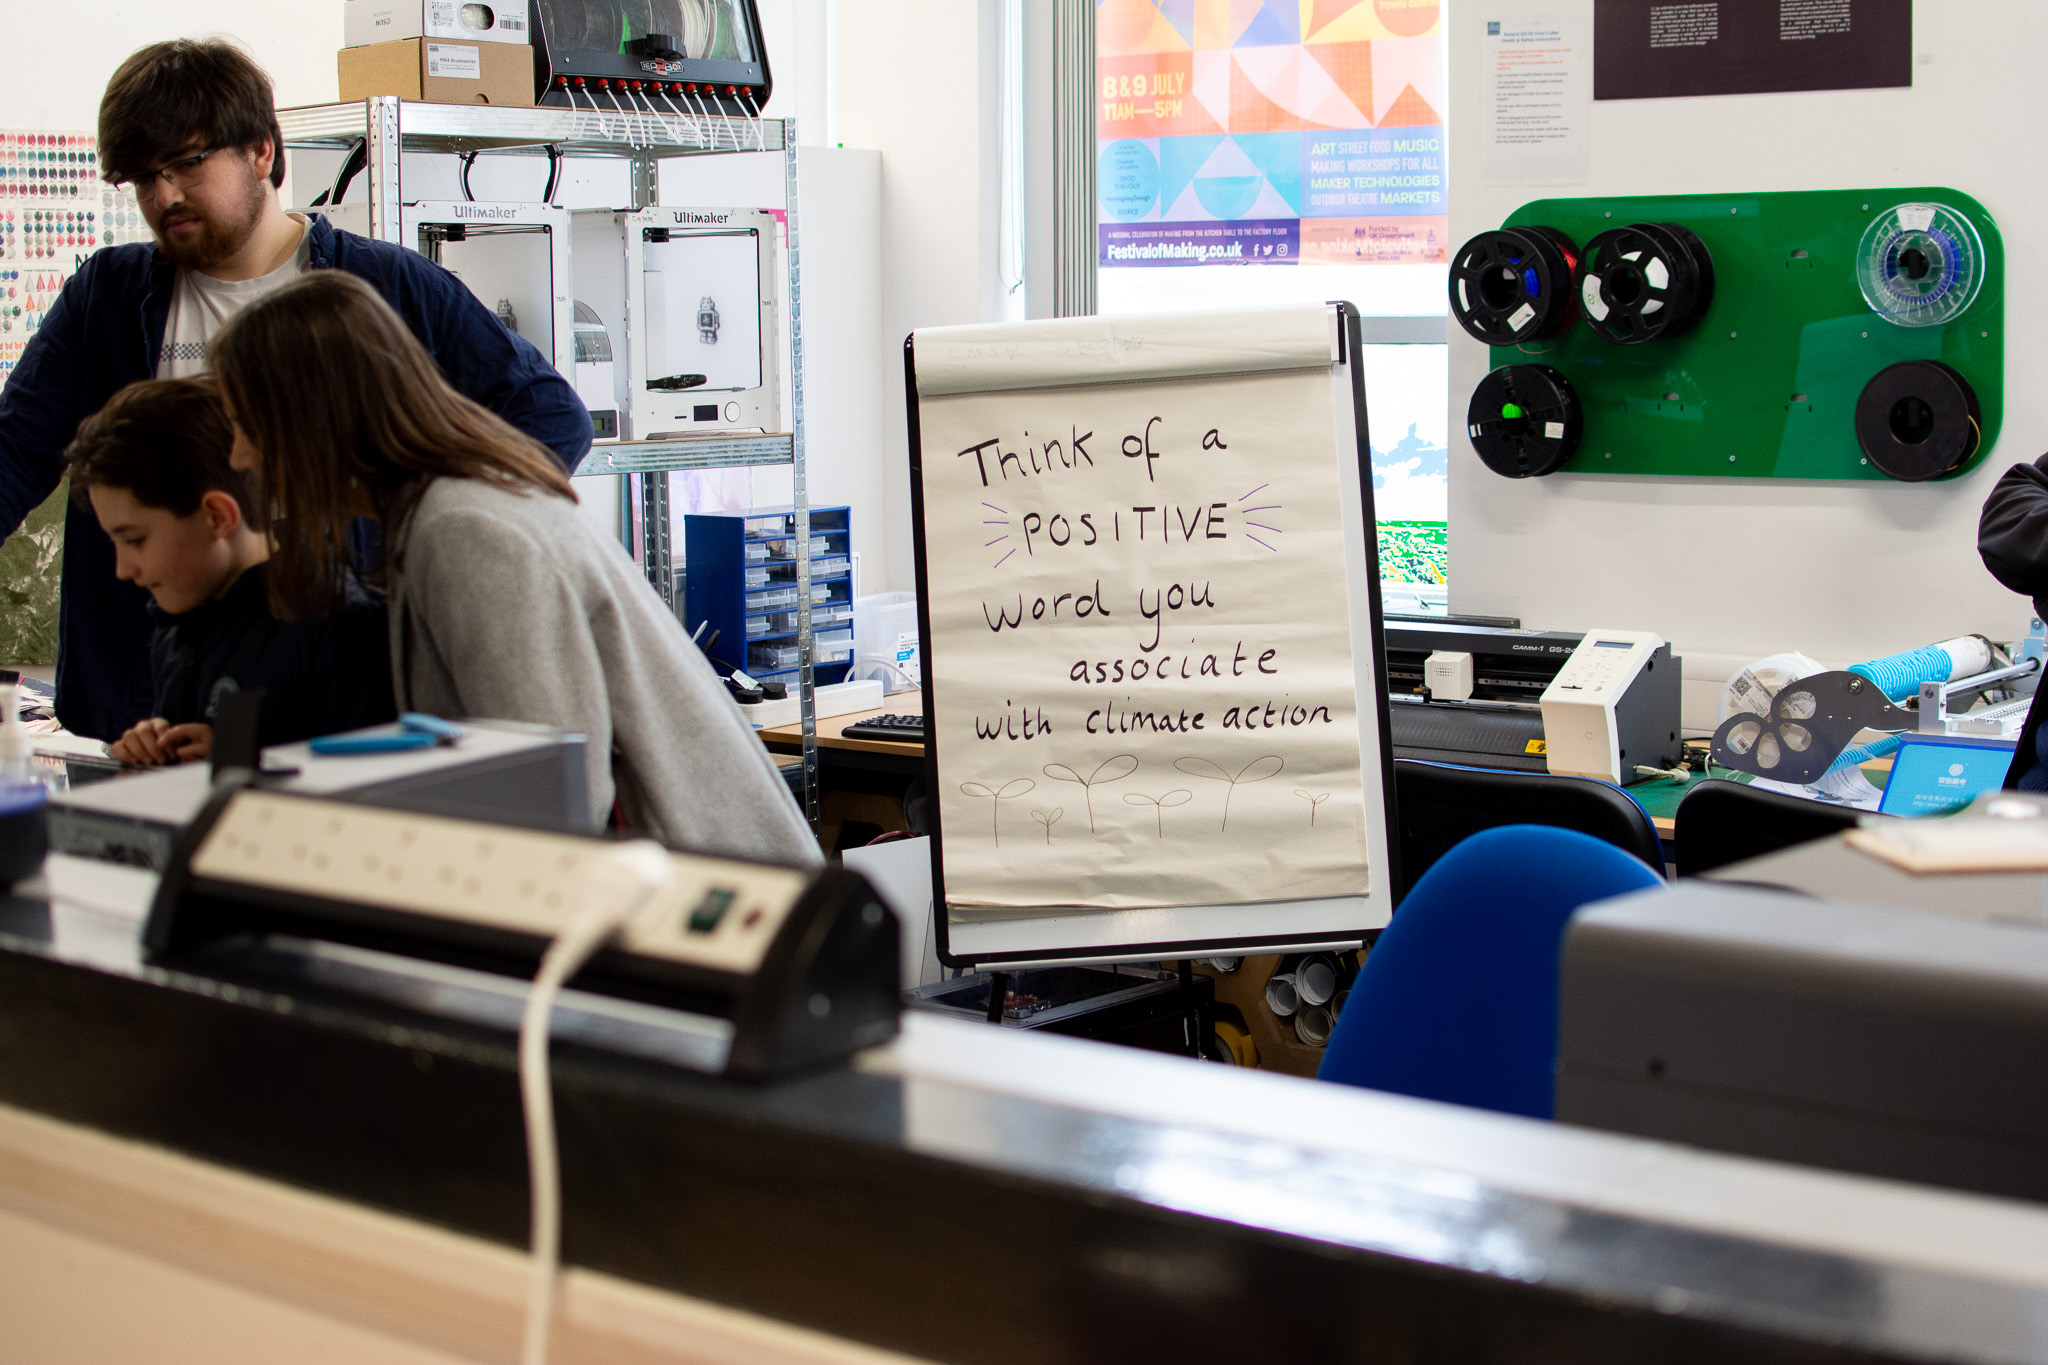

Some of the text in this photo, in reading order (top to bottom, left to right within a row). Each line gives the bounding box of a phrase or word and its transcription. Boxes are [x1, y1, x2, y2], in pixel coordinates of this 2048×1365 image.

[1150, 72, 1184, 96] JULY
[1311, 138, 1439, 155] ART STREET FOOD MUSIC
[1311, 156, 1439, 173] MAKING WORKSHOPS FOR ALL
[1311, 174, 1440, 189] MAKER TECHNOLOGIES
[1311, 191, 1440, 206] OUTDOOR THEATRE MARKETS
[453, 205, 517, 218] Ultimaker
[673, 211, 729, 223] Ultimaker
[1253, 228, 1271, 236] FACTORY
[1107, 241, 1243, 262] FestivalofMaking.co.uk
[957, 416, 1228, 487] Think of a
[1022, 502, 1228, 556] POSITIVE
[1139, 579, 1215, 654] you
[1069, 638, 1279, 684] associate
[975, 694, 1333, 741] with climate action
